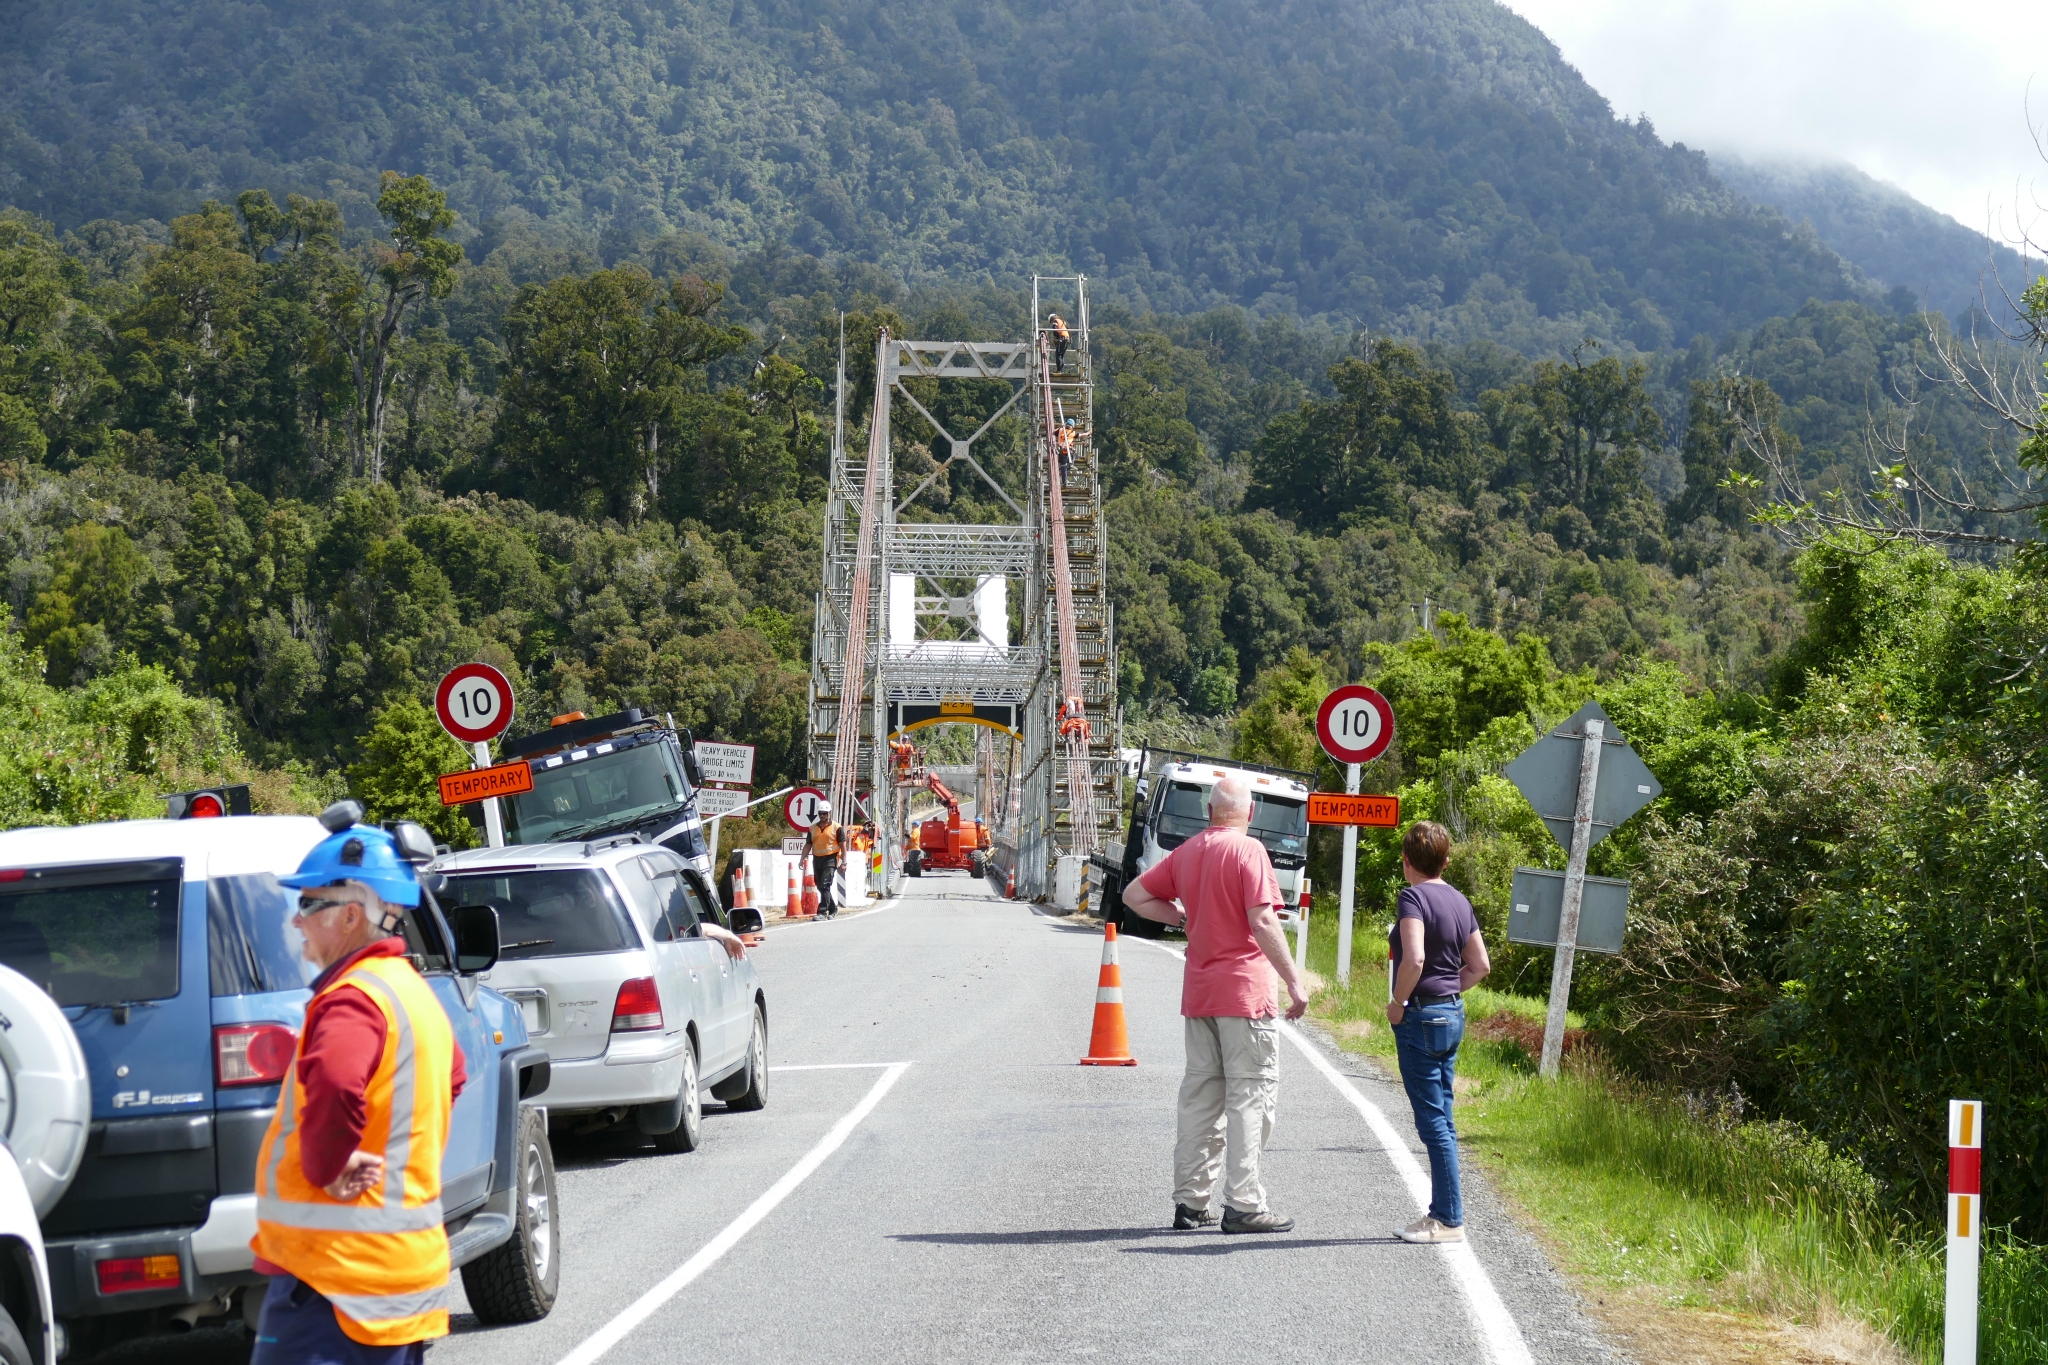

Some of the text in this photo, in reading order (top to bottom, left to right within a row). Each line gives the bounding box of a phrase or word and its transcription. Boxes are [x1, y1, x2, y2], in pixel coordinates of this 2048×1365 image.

[458, 687, 492, 718] 10
[1342, 709, 1370, 738] 10
[701, 746, 747, 758] HEAVY VEHICLE
[701, 757, 745, 769] BRIDGE LIMITS
[704, 769, 717, 777] PEED
[446, 769, 523, 797] TEMPORARY
[701, 790, 738, 799] HEAVY VEHICLES
[702, 797, 735, 807] CROSS BRIDGE
[1314, 801, 1392, 819] TEMPORARY
[788, 842, 804, 851] GIVE
[112, 1090, 151, 1108] FJ
